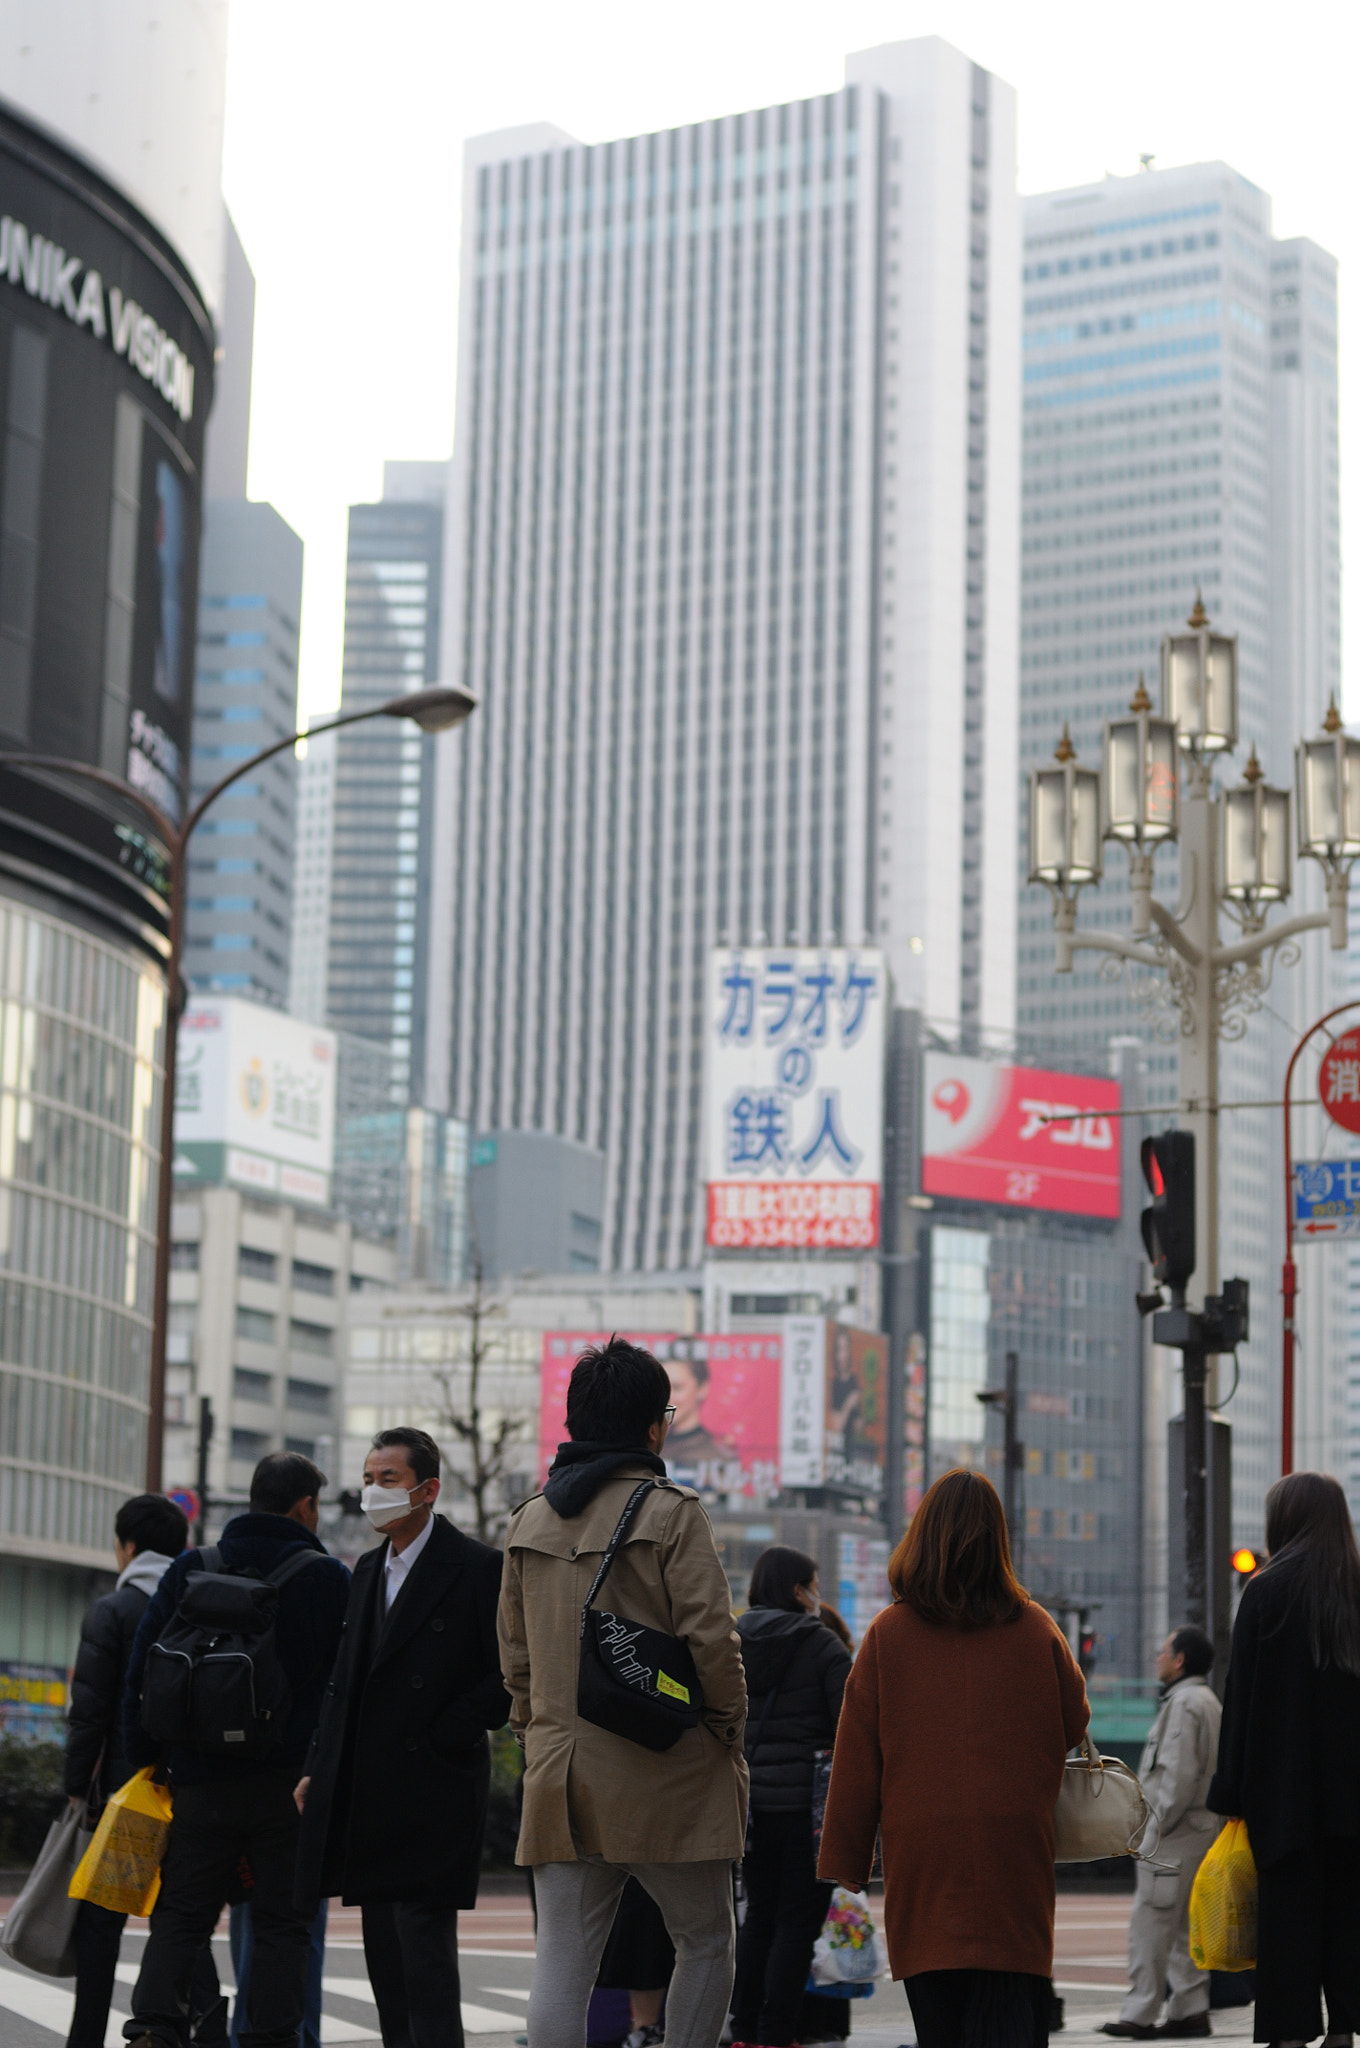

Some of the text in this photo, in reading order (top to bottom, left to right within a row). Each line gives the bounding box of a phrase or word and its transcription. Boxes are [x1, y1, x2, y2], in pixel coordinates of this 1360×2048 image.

[109, 285, 194, 421] VISION
[719, 957, 879, 1042] カラオケ
[779, 1044, 815, 1090] の
[729, 1092, 858, 1168] 鉄人
[1019, 1099, 1112, 1150] アコム
[1007, 1171, 1040, 1200] 2F
